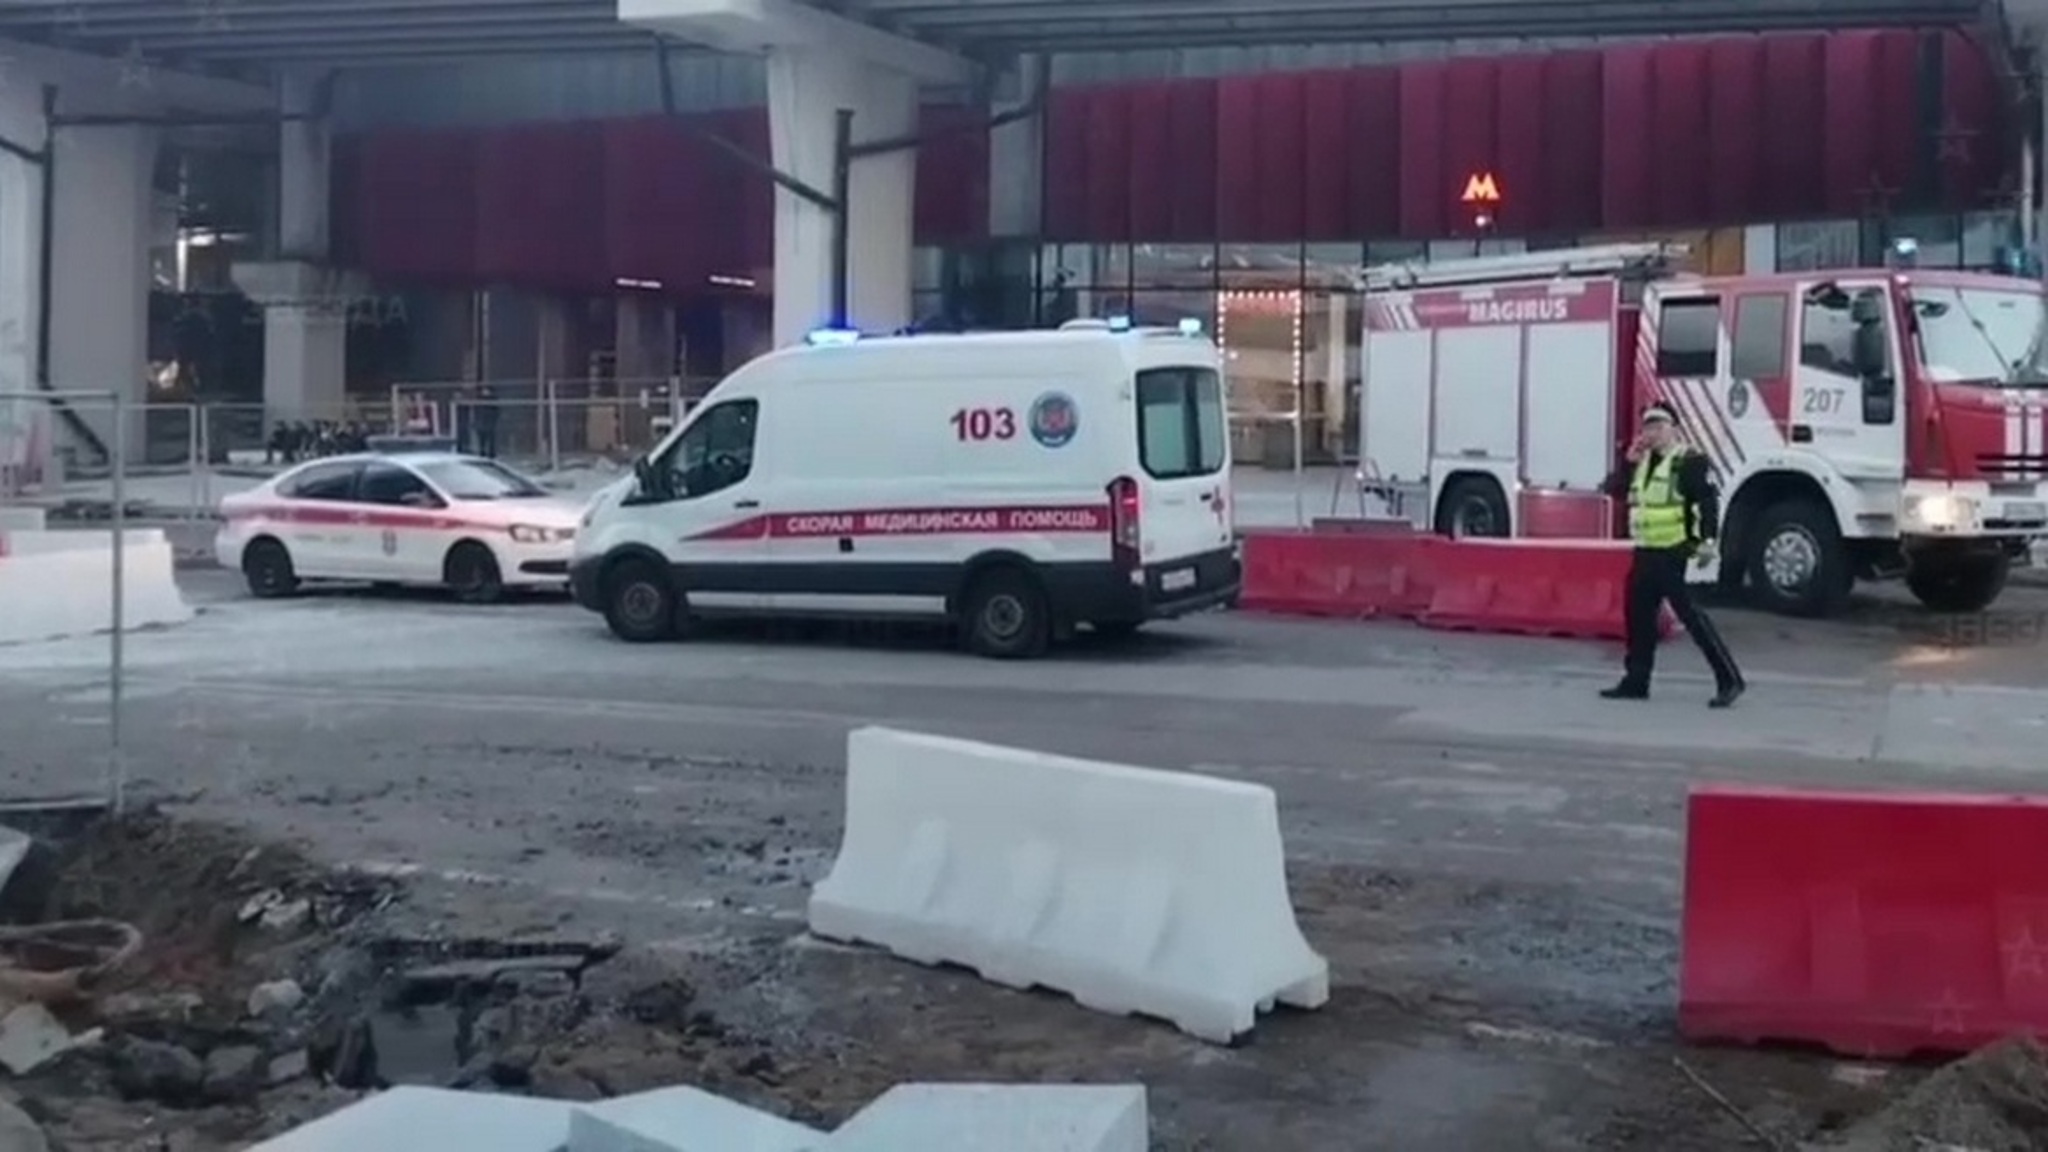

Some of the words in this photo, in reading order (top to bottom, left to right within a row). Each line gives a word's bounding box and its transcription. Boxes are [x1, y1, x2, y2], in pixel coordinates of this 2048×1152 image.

[1461, 172, 1500, 200] М
[1468, 298, 1568, 323] MAGIRUS
[1804, 387, 1845, 414] 207
[949, 406, 1016, 441] 103
[786, 515, 853, 533] СКОРАЯ
[864, 512, 998, 532] МЕДИЦИНСКАЯ
[1010, 509, 1098, 529] ПОМОЩЬ
